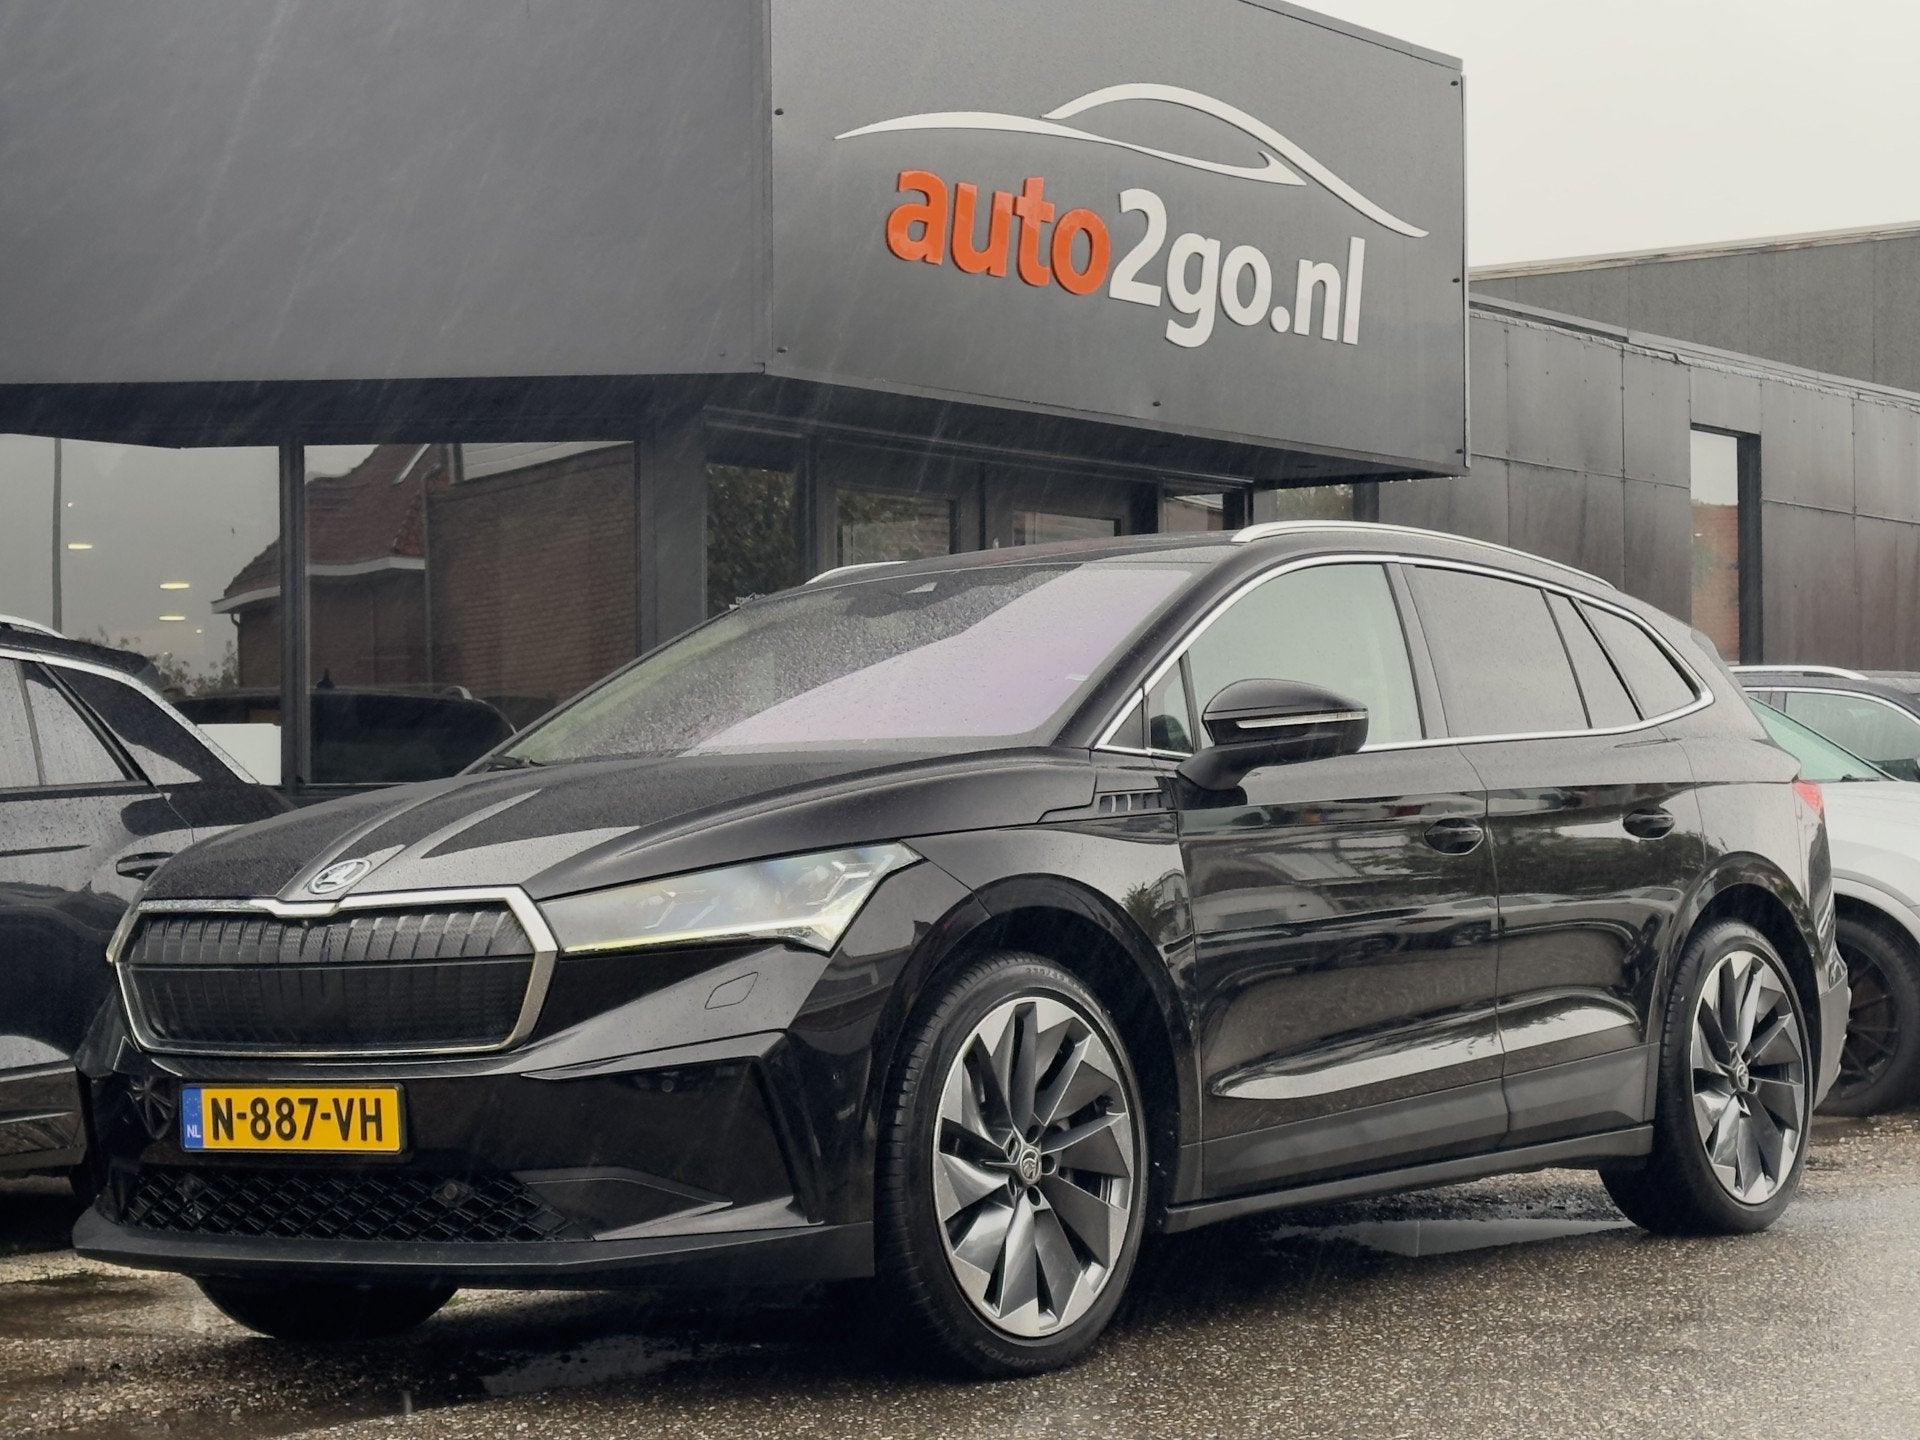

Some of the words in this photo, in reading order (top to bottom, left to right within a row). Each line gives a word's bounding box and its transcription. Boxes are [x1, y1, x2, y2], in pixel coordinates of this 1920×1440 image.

[886, 169, 1366, 349] auto2go.nl
[186, 1124, 201, 1138] NL
[210, 1096, 383, 1142] N-887-VH
